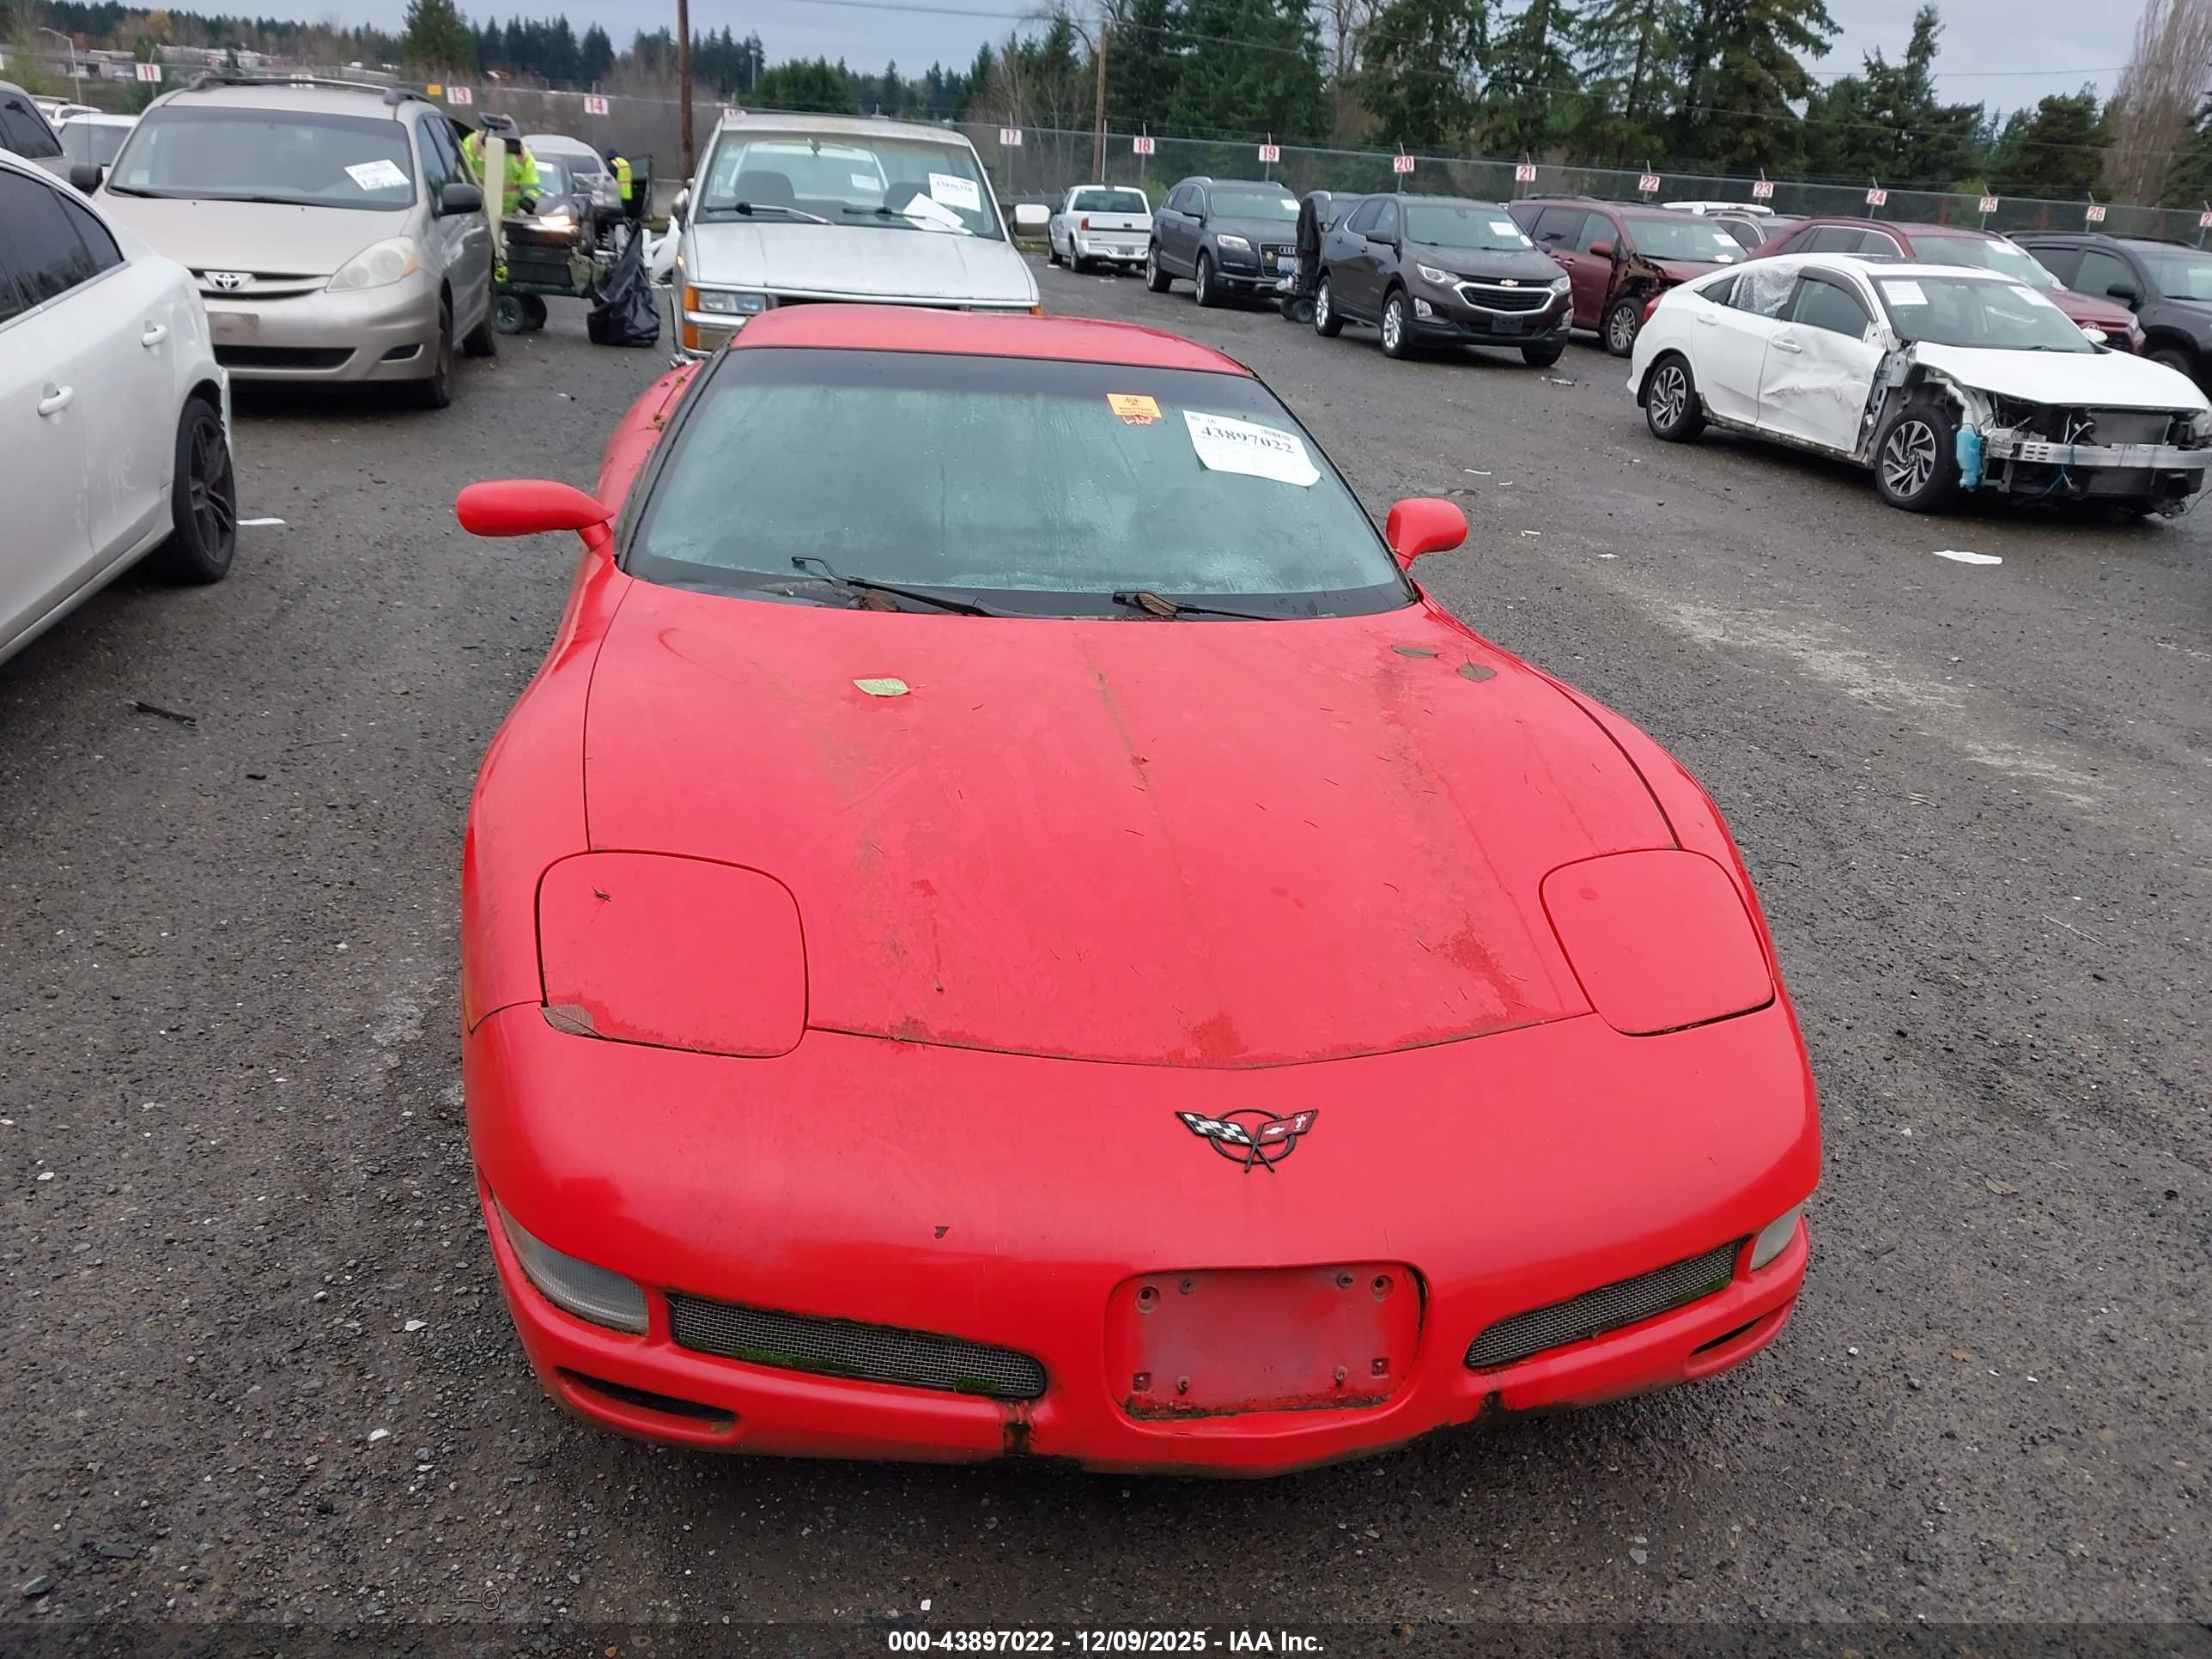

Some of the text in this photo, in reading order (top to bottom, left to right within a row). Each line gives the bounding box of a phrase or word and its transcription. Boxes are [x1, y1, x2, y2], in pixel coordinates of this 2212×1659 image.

[142, 65, 155, 81] 11
[453, 88, 468, 103] 13
[589, 97, 605, 112] 14
[1005, 130, 1017, 144] 17
[1138, 137, 1151, 153] 18
[1263, 145, 1276, 161] 19
[1396, 156, 1412, 171] 20
[1519, 166, 1532, 180] 21
[1642, 176, 1657, 191] 22
[1756, 182, 1771, 197] 23
[1869, 191, 1882, 204] 24
[1981, 198, 1996, 212] 25
[2088, 207, 2103, 221] 26
[2202, 213, 2212, 227] 2
[1200, 426, 1295, 454] 43897022
